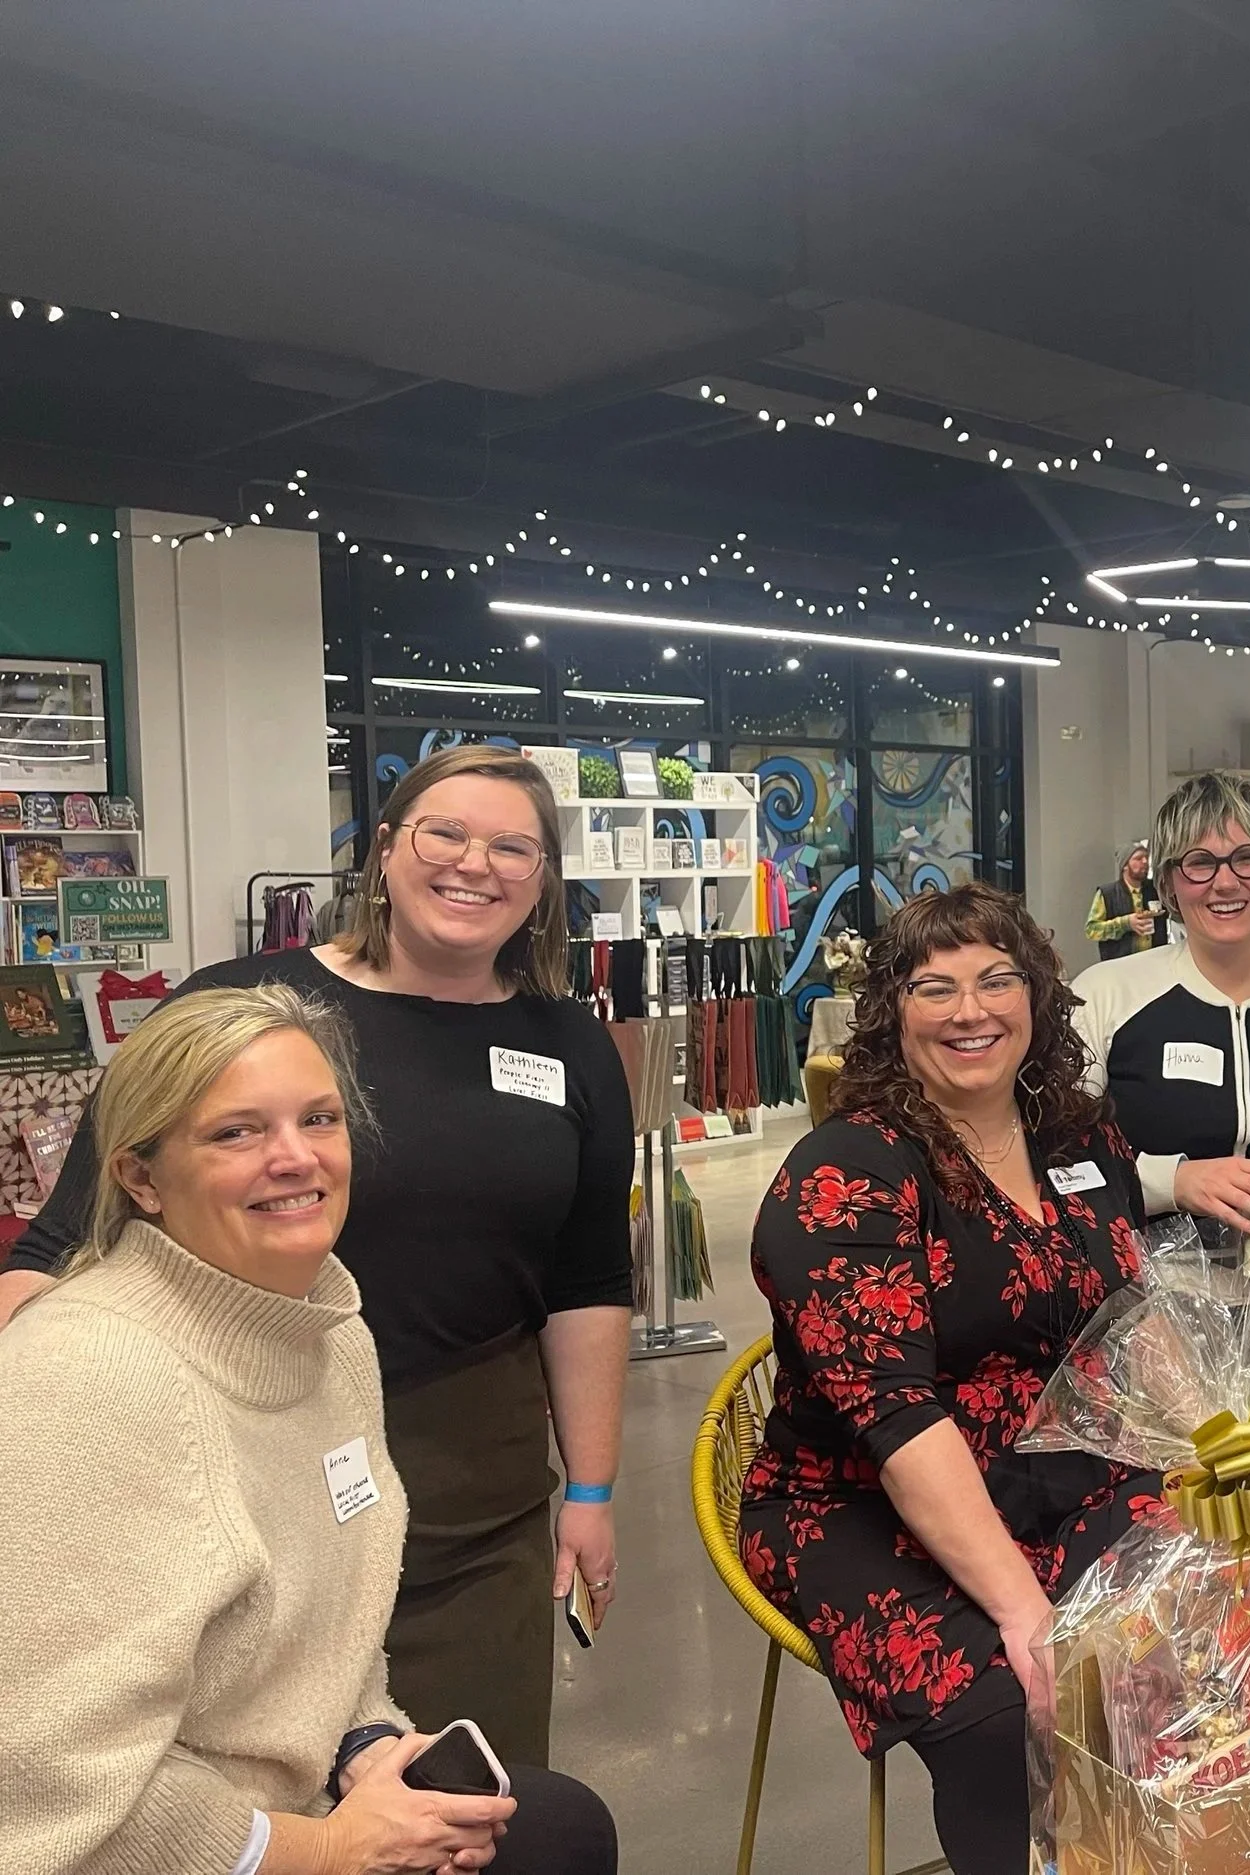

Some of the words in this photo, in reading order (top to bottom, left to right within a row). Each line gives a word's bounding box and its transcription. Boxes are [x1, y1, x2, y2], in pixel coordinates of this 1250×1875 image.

[109, 895, 161, 910] SNAP!
[102, 913, 147, 924] FOLLOW
[149, 912, 163, 922] US
[497, 1050, 558, 1074] Kathleen
